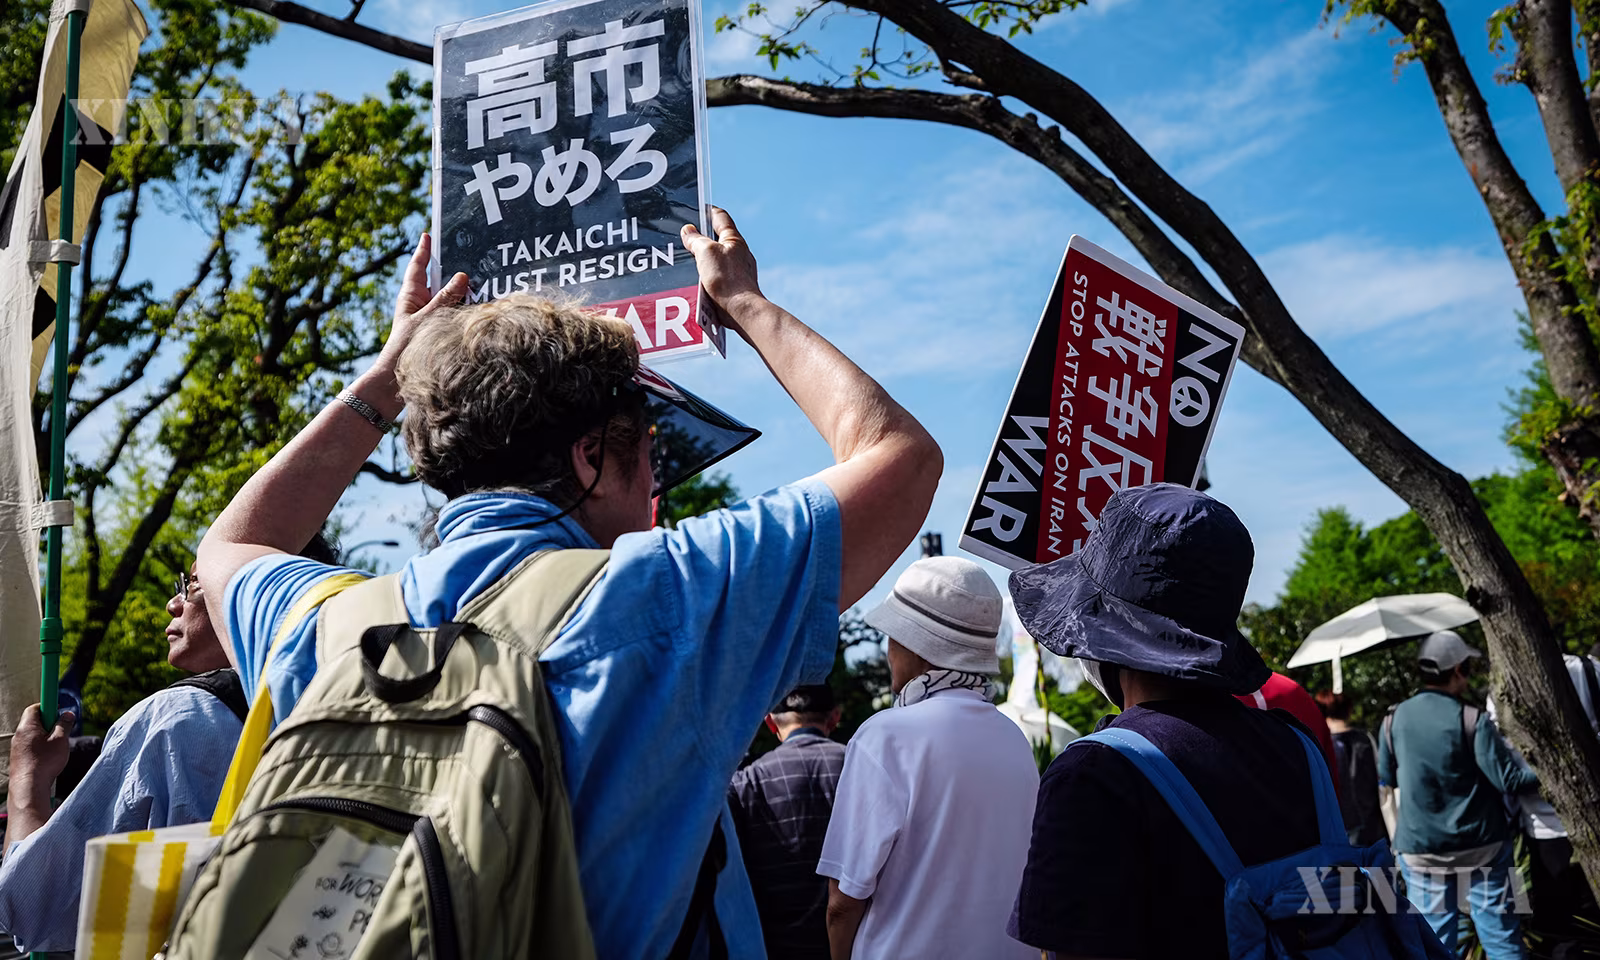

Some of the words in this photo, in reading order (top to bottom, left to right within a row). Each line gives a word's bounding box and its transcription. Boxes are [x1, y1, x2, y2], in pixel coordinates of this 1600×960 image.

[465, 19, 665, 150] 高市
[464, 123, 668, 226] やめろ
[465, 267, 547, 305] MUST
[559, 242, 674, 287] RESIGN
[498, 217, 639, 267] TAKAICHI
[601, 296, 694, 350] AR
[1069, 271, 1088, 337] STOP
[1057, 341, 1080, 447] ATTACKS
[1169, 322, 1232, 427] NO
[1073, 291, 1167, 552] 戦争反
[971, 415, 1050, 542] WAR
[1053, 453, 1069, 492] ON
[1047, 497, 1065, 555] IRAN
[315, 877, 337, 891] FOR
